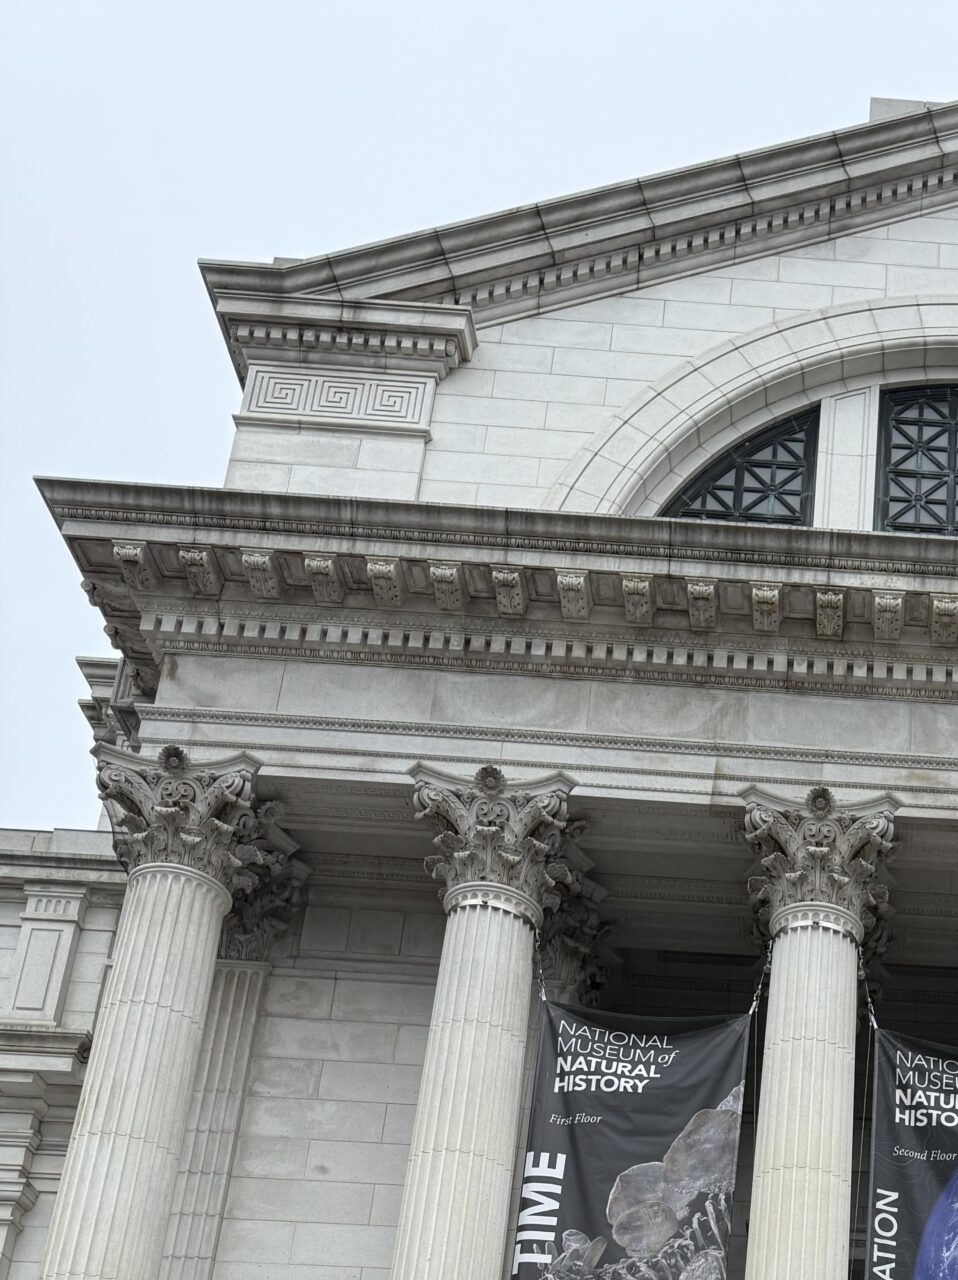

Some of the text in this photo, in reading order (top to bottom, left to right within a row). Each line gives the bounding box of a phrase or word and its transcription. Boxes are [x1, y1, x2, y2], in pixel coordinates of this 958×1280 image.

[558, 1019, 674, 1049] NATIONAL
[557, 1037, 680, 1068] MUSEUM of
[556, 1055, 661, 1078] NATURAL
[553, 1074, 650, 1094] HISTORY
[549, 1112, 602, 1126] First Floor
[892, 1145, 958, 1161] Second Floor
[511, 1151, 566, 1275] TIME
